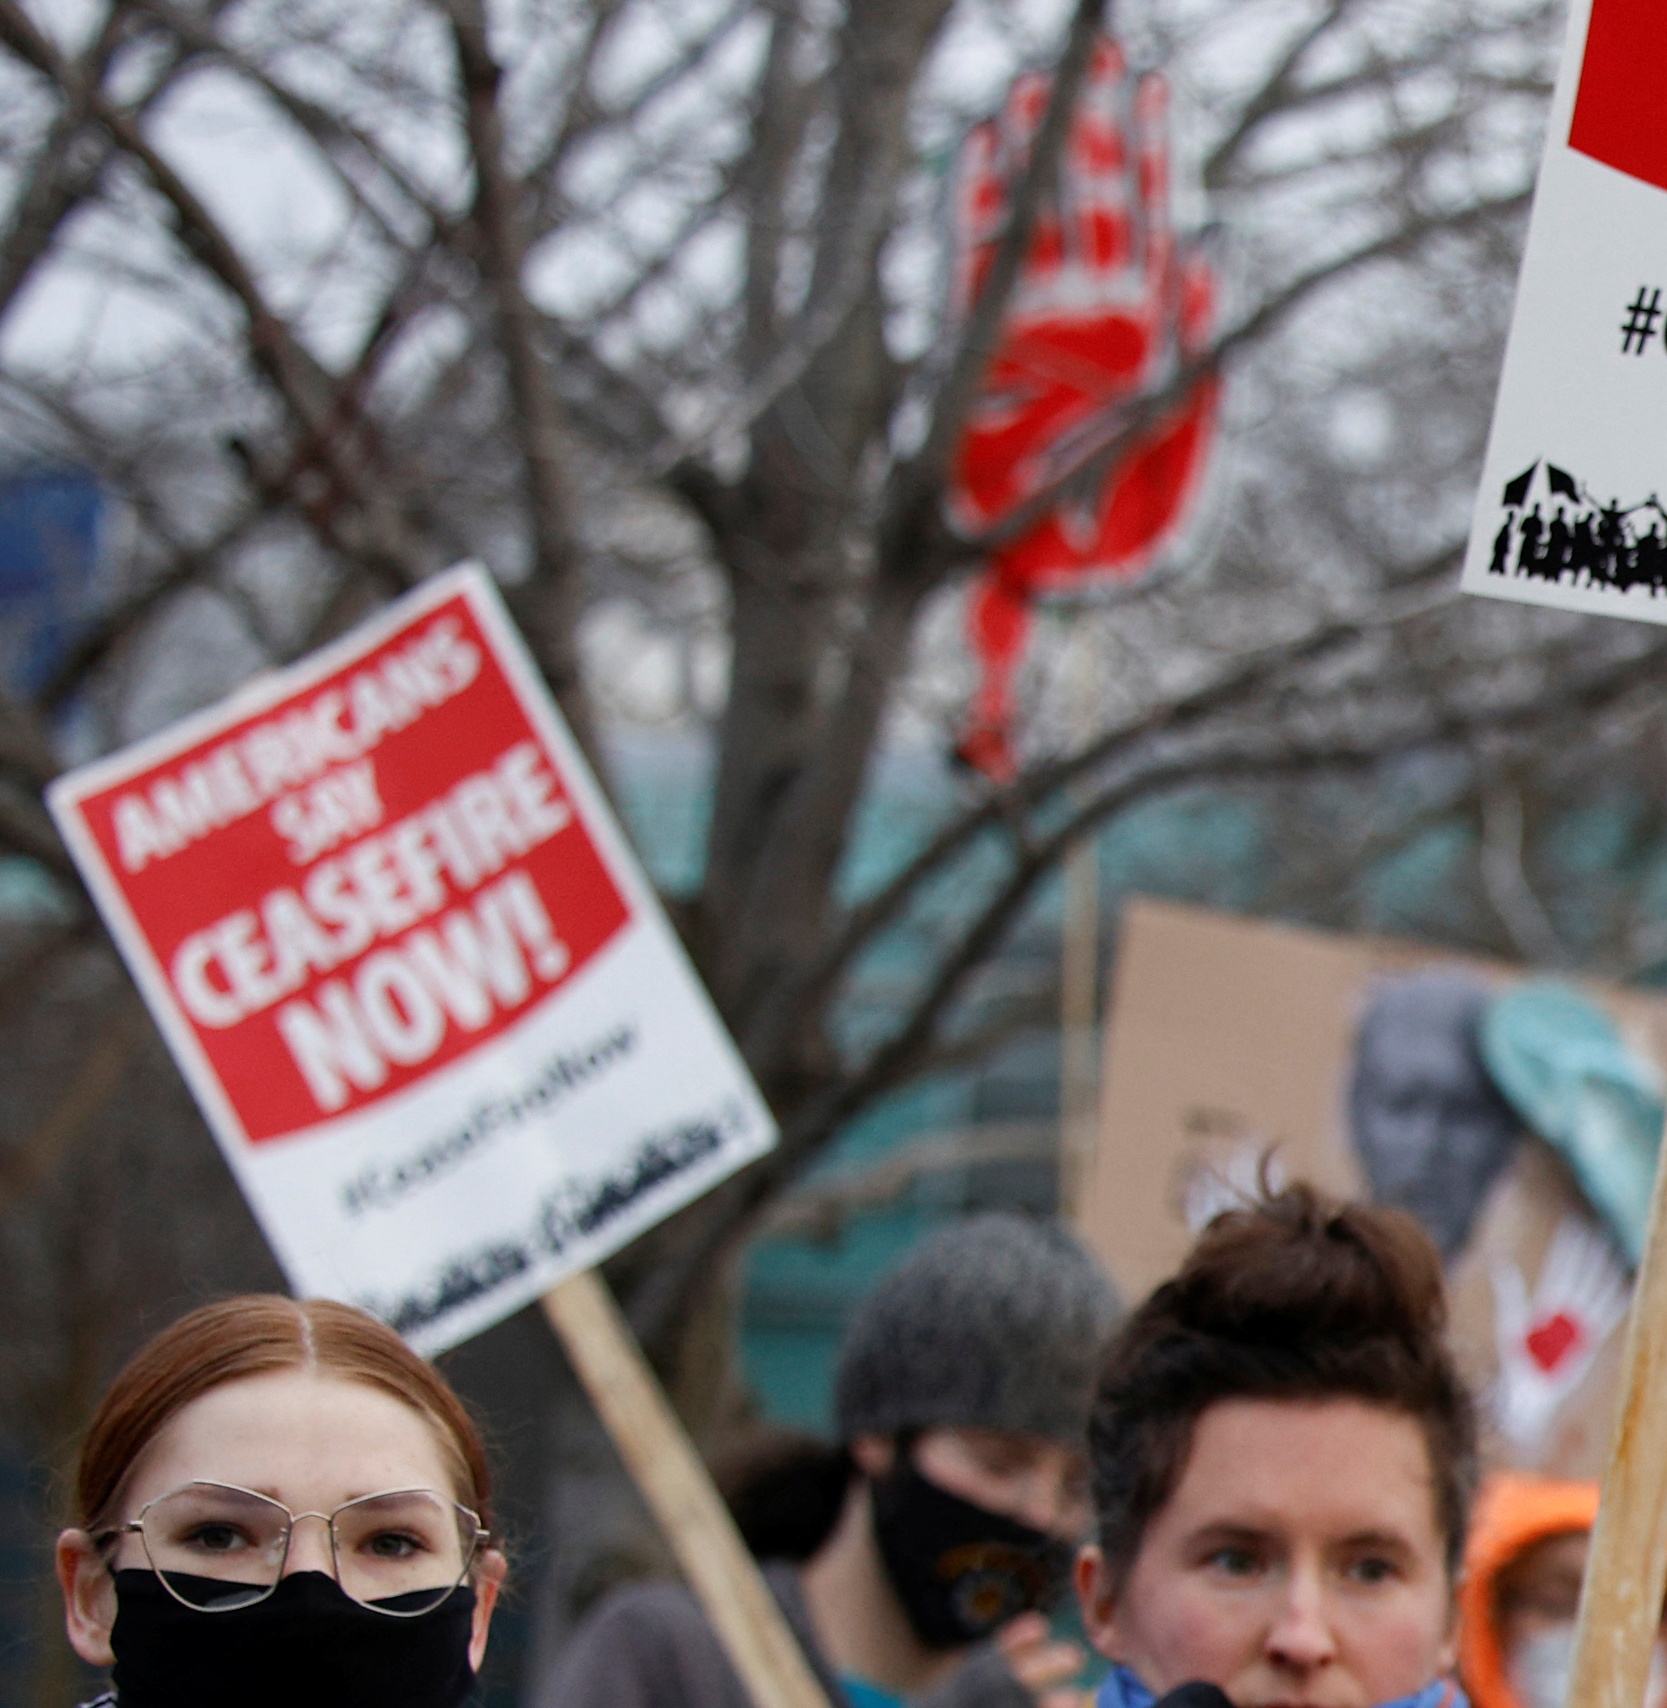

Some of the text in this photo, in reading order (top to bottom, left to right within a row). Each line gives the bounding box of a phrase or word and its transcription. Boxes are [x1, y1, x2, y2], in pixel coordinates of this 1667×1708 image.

[111, 614, 485, 873] AMERICANS
[269, 756, 387, 866] SAY
[172, 741, 574, 1030] CEASEFIRE
[278, 869, 572, 1113] NOW!
